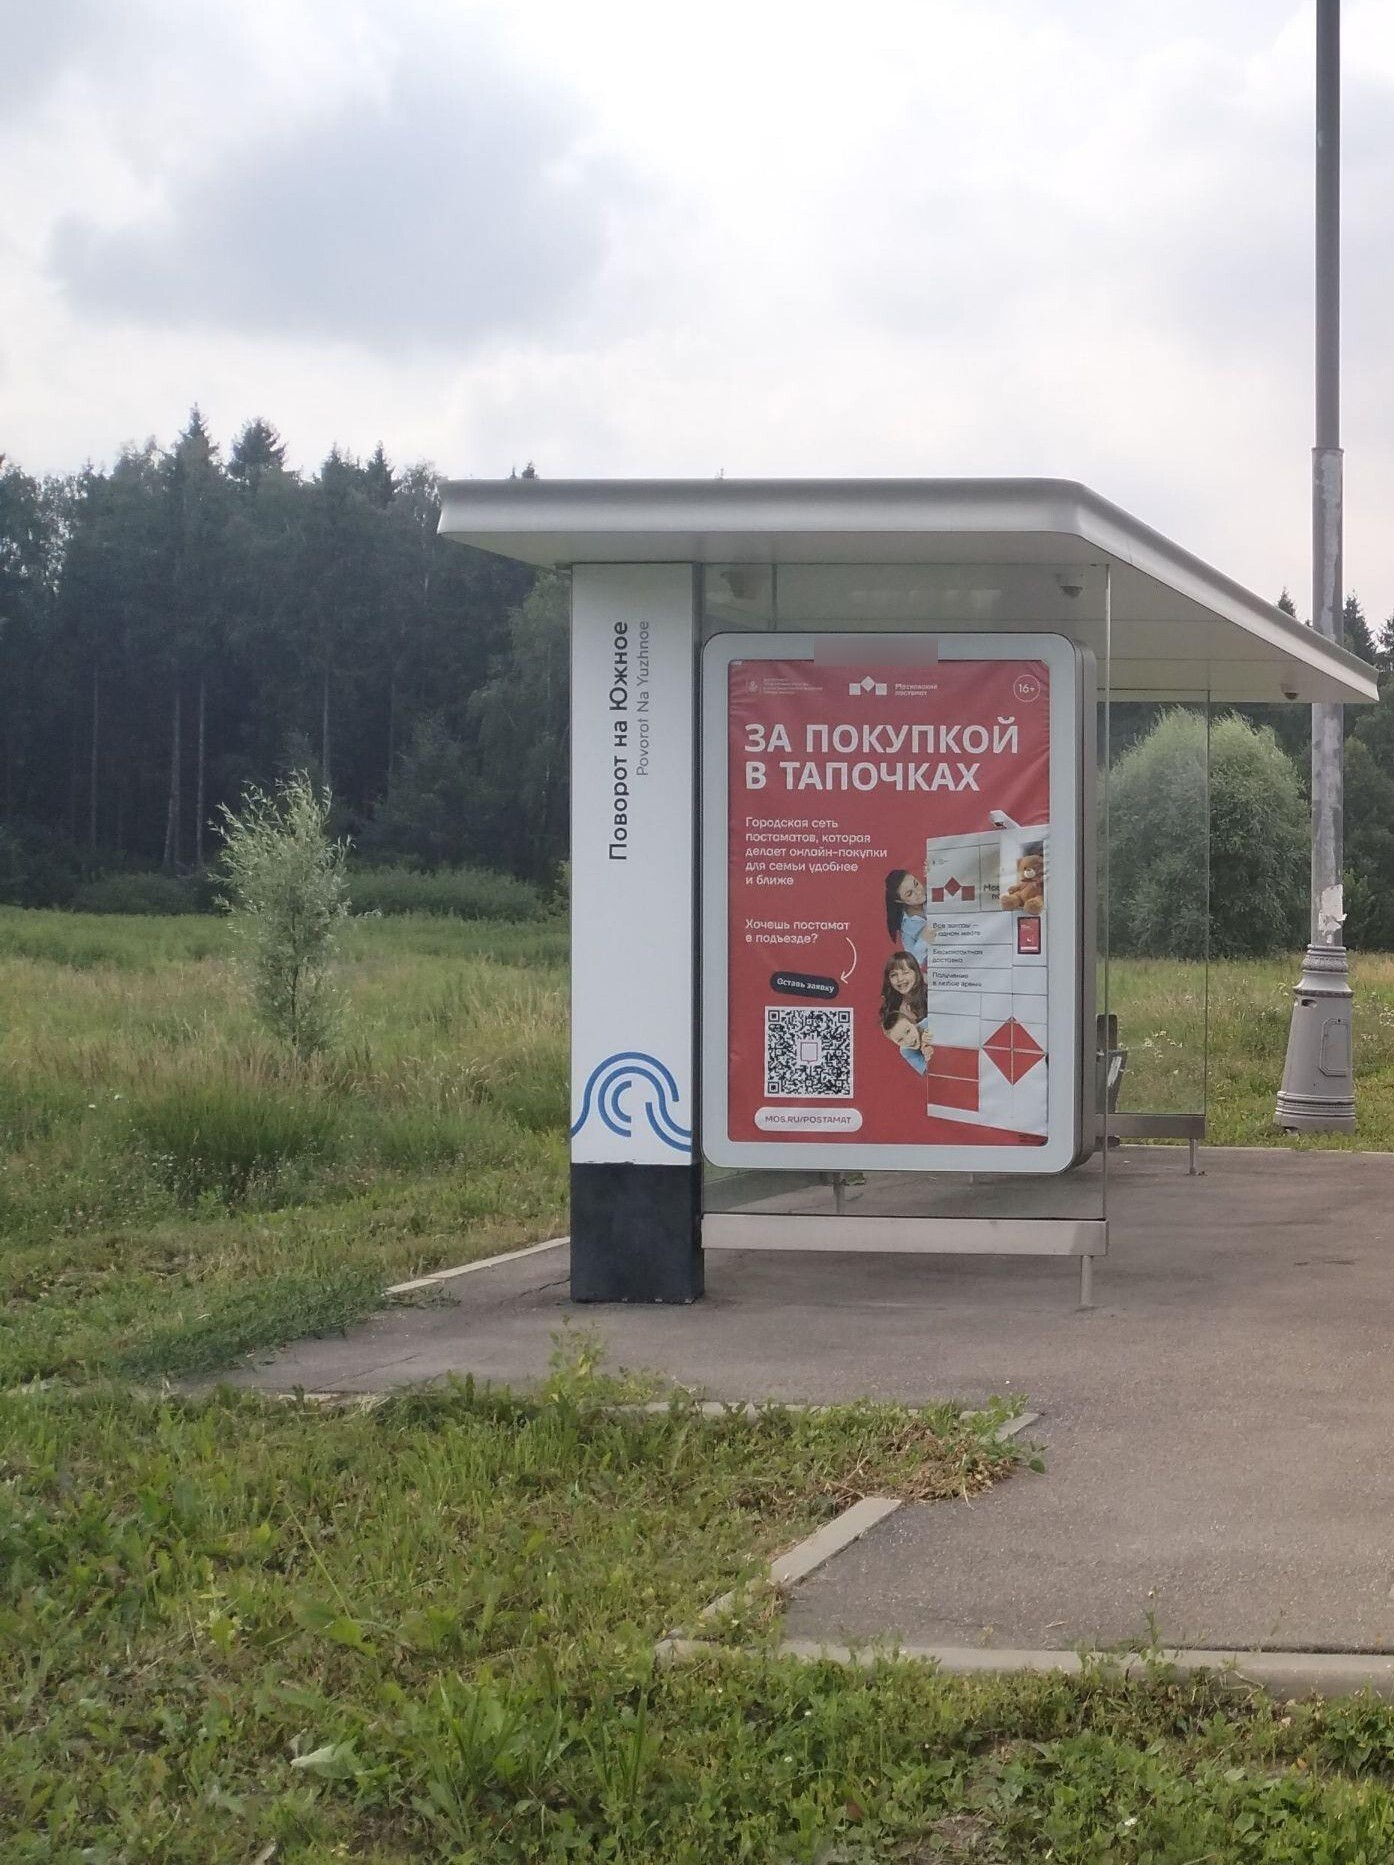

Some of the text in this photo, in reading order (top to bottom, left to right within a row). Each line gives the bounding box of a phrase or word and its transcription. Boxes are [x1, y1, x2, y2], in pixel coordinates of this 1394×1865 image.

[1018, 683, 1035, 693] 16+
[636, 620, 649, 776] Povorot Na Yuzhnoe
[608, 621, 629, 860] Поворот на Южное
[744, 716, 1018, 754] ЗА ПОКУПКОЙ
[745, 761, 980, 791] В ТАПОЧКАХ
[745, 816, 839, 829] Городская сеть
[745, 833, 871, 846] постаматов, которая
[745, 846, 888, 859] делает онлайн-покупки
[745, 861, 859, 874] для семьи удобнее
[745, 874, 794, 885] и ближе
[745, 918, 850, 931] Хочешь постамат
[745, 932, 818, 945] в подъезде?
[764, 1115, 852, 1125] MOS.RU/POSTAMAT
